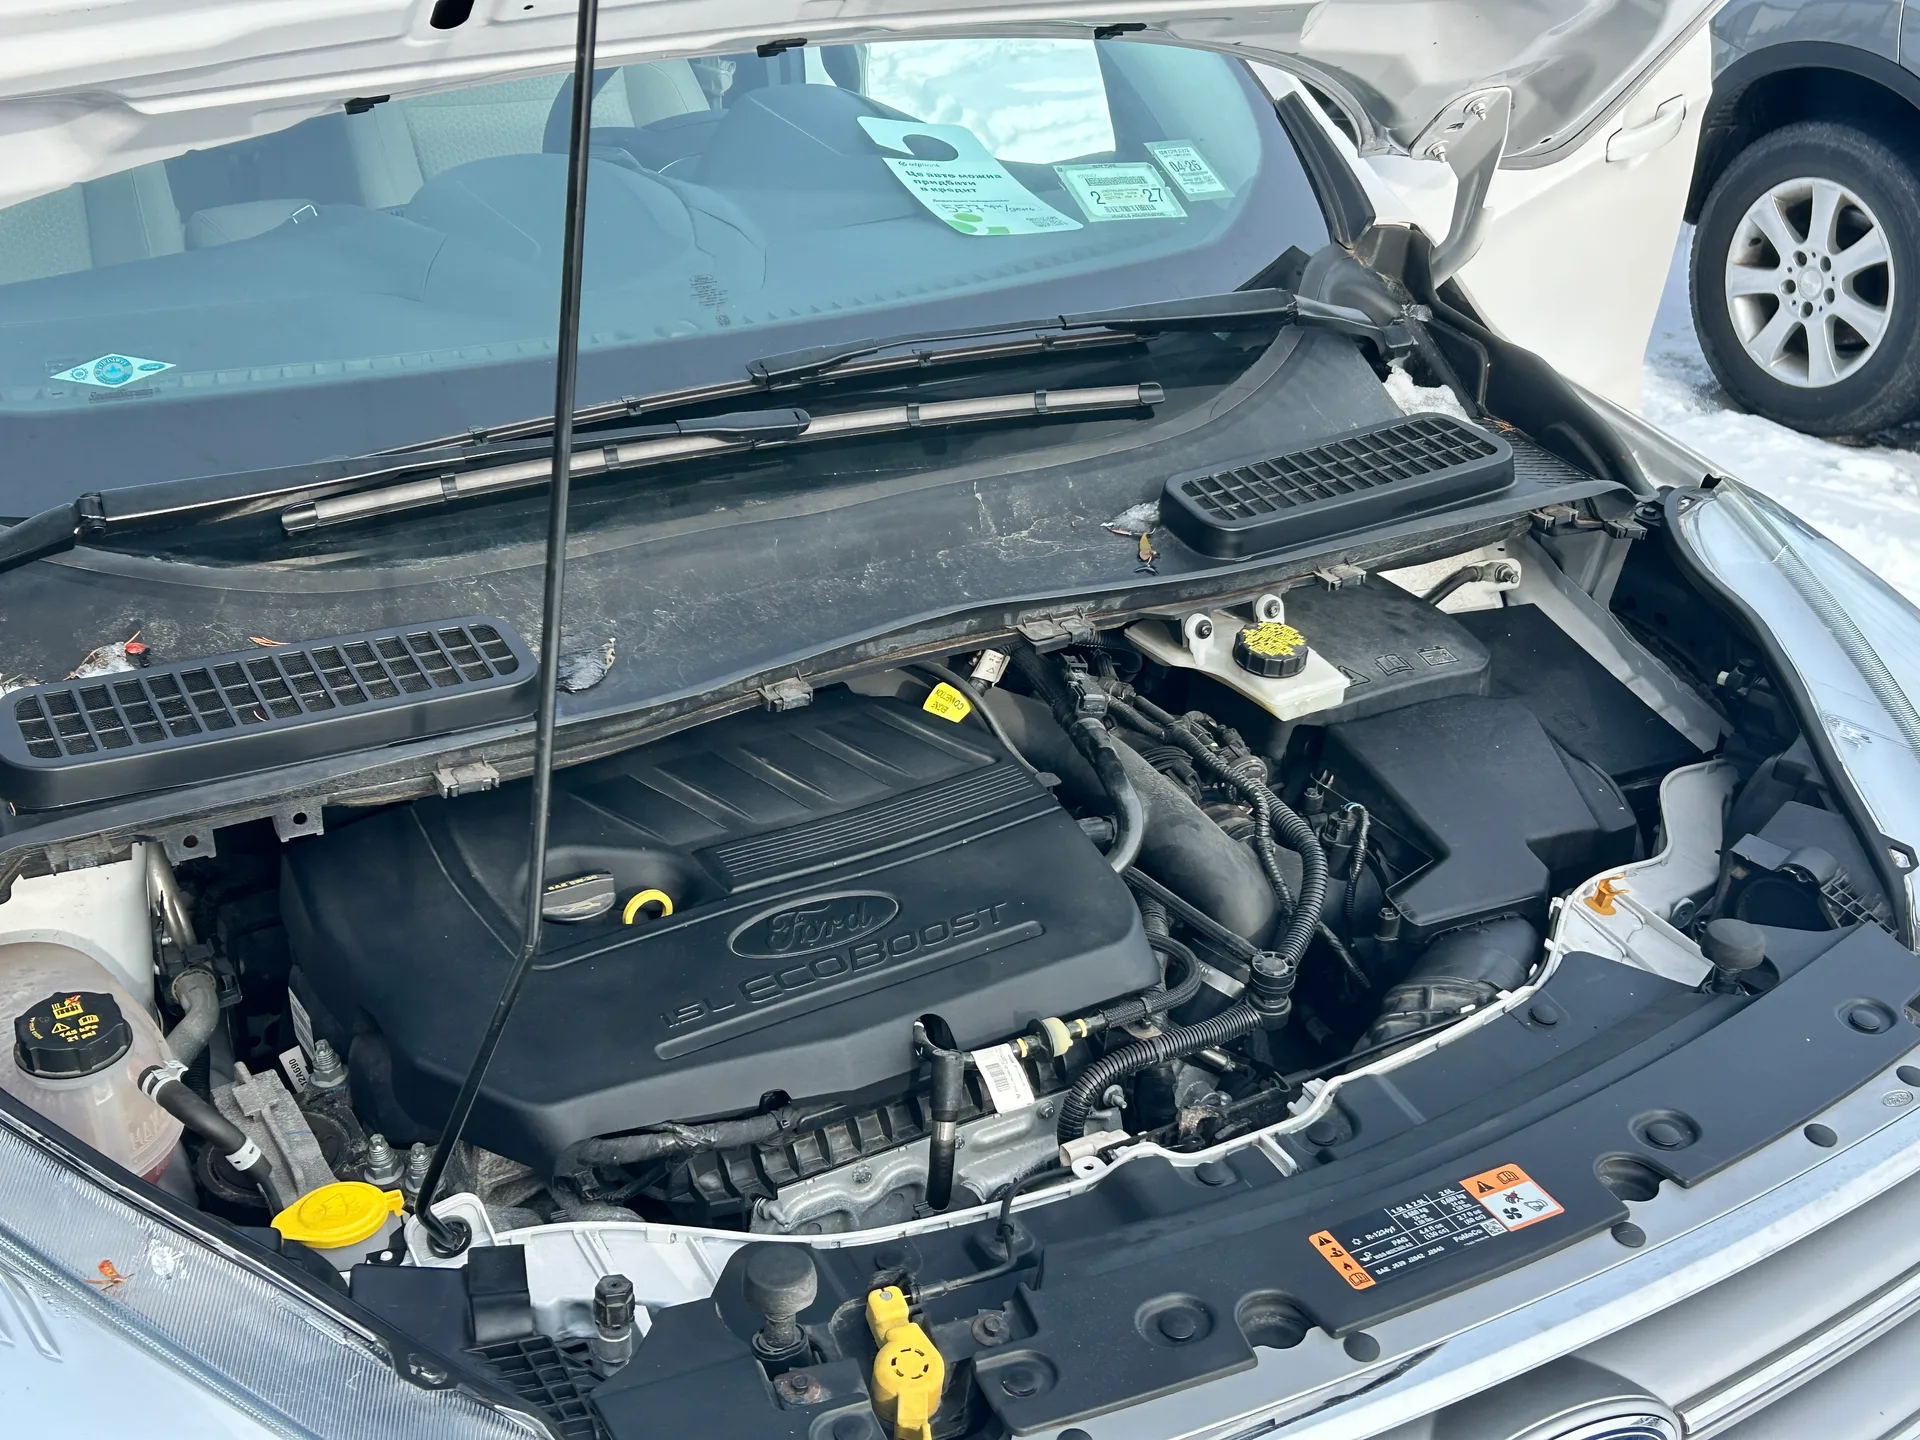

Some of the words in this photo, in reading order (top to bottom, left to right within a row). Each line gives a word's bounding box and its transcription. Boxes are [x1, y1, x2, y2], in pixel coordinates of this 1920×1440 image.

[905, 170, 924, 178] Це
[913, 179, 977, 187] придбати
[1090, 190, 1106, 205] 2
[1142, 187, 1164, 203] 27
[766, 901, 873, 951] Ford
[658, 998, 737, 1028] 1.5L
[737, 901, 1008, 1004] ECOBOOST
